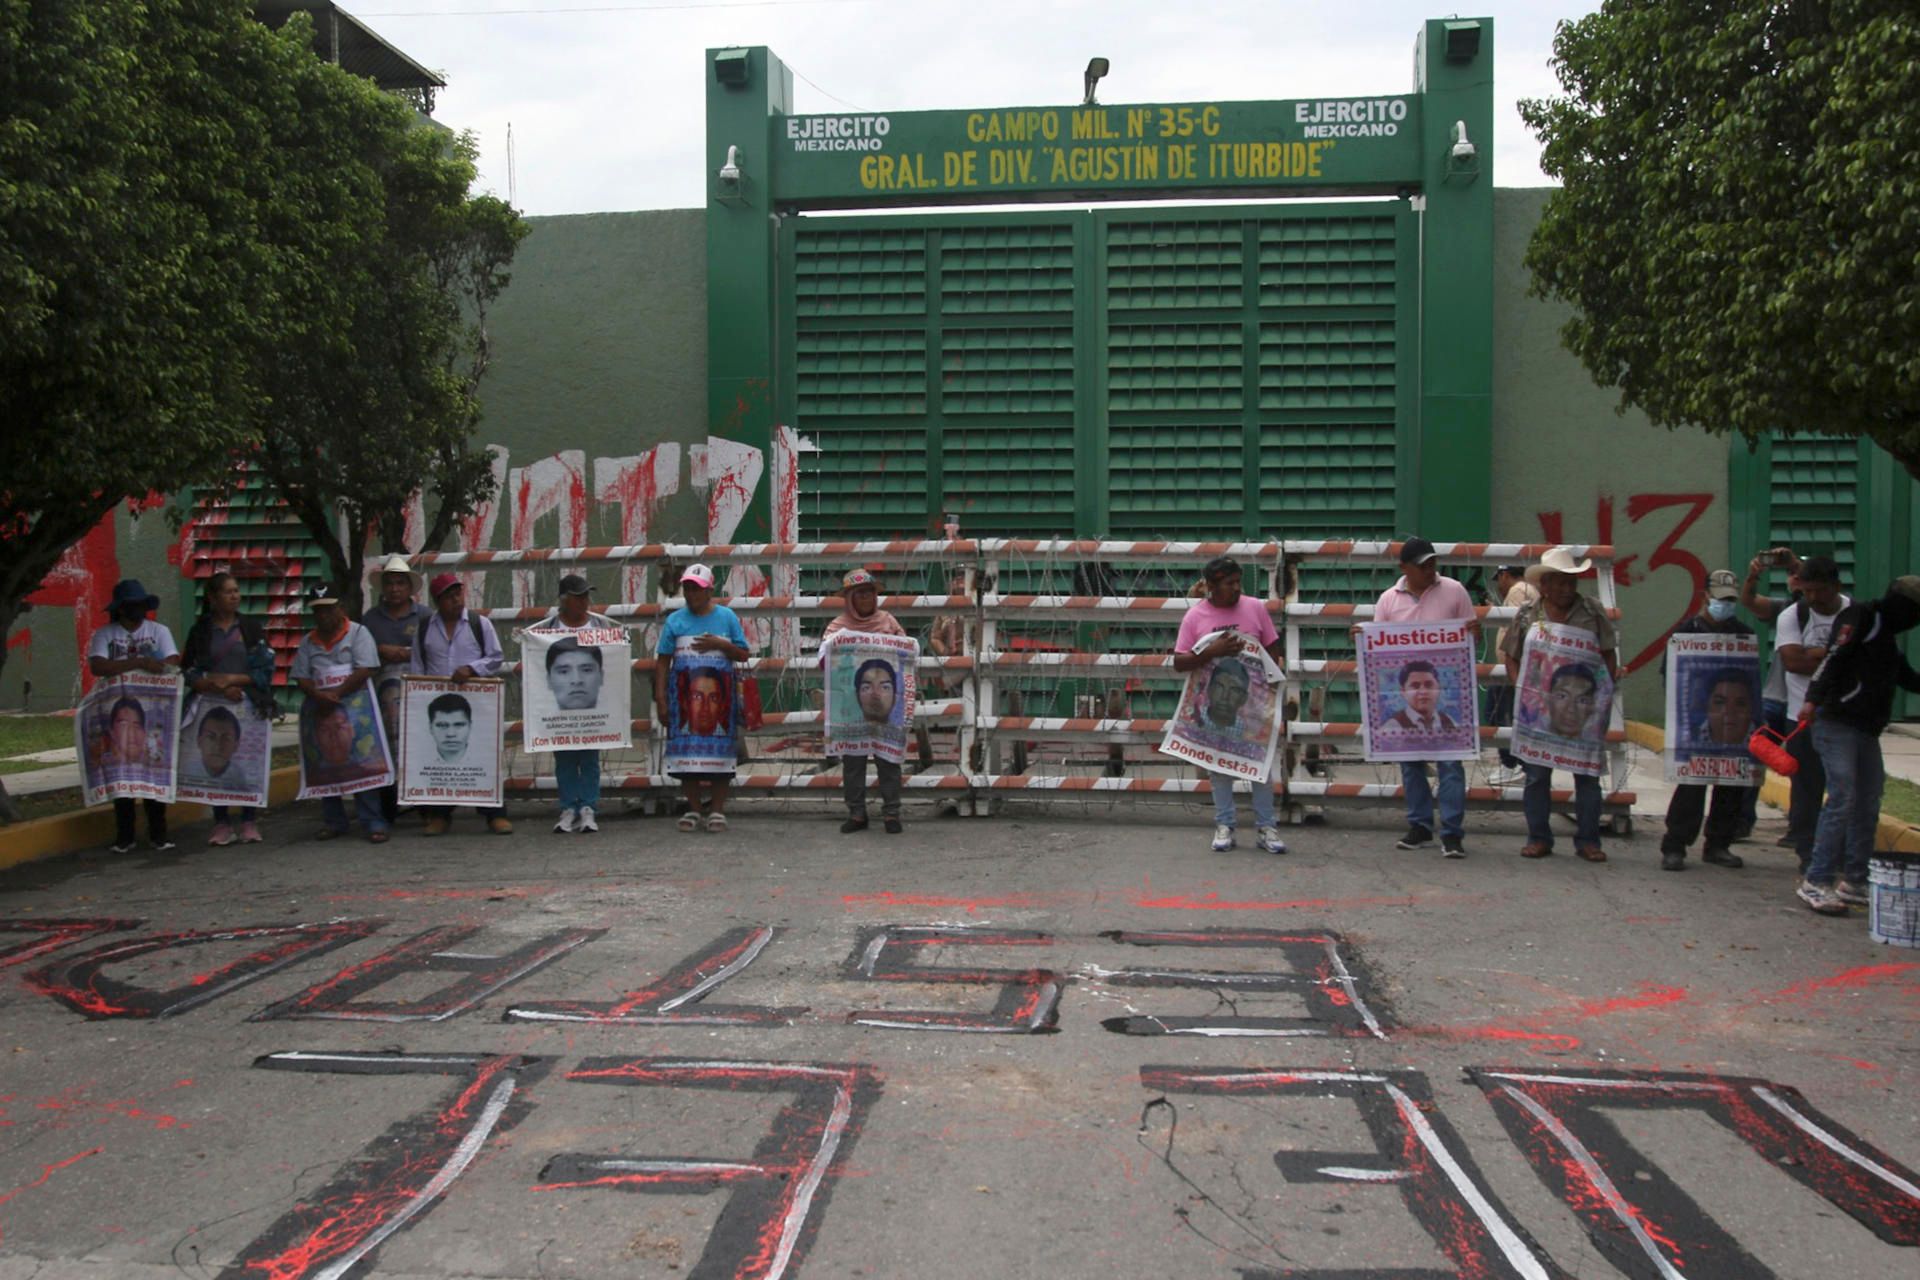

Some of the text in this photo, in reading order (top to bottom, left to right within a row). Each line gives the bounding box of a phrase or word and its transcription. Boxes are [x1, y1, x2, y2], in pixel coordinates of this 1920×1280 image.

[1295, 100, 1407, 123] EJERCITO
[787, 116, 891, 139] EJERCITO
[967, 110, 1059, 142] CAMPO
[1072, 108, 1120, 139] MIL.
[1159, 106, 1221, 137] 35-C
[1303, 123, 1398, 138] MEXICANO
[795, 138, 883, 151] MEXICANO
[860, 154, 938, 190] GRAL.
[944, 151, 977, 186] DE
[990, 147, 1038, 183] DIV.
[1168, 143, 1198, 179] DE
[577, 630, 593, 644] NOS
[597, 627, 623, 643] FALTAN
[1367, 627, 1466, 650] ¡Justicia!
[1711, 641, 1722, 651] se
[552, 735, 570, 745] VIDA
[1217, 756, 1259, 777] están
[426, 788, 444, 796] VIDA
